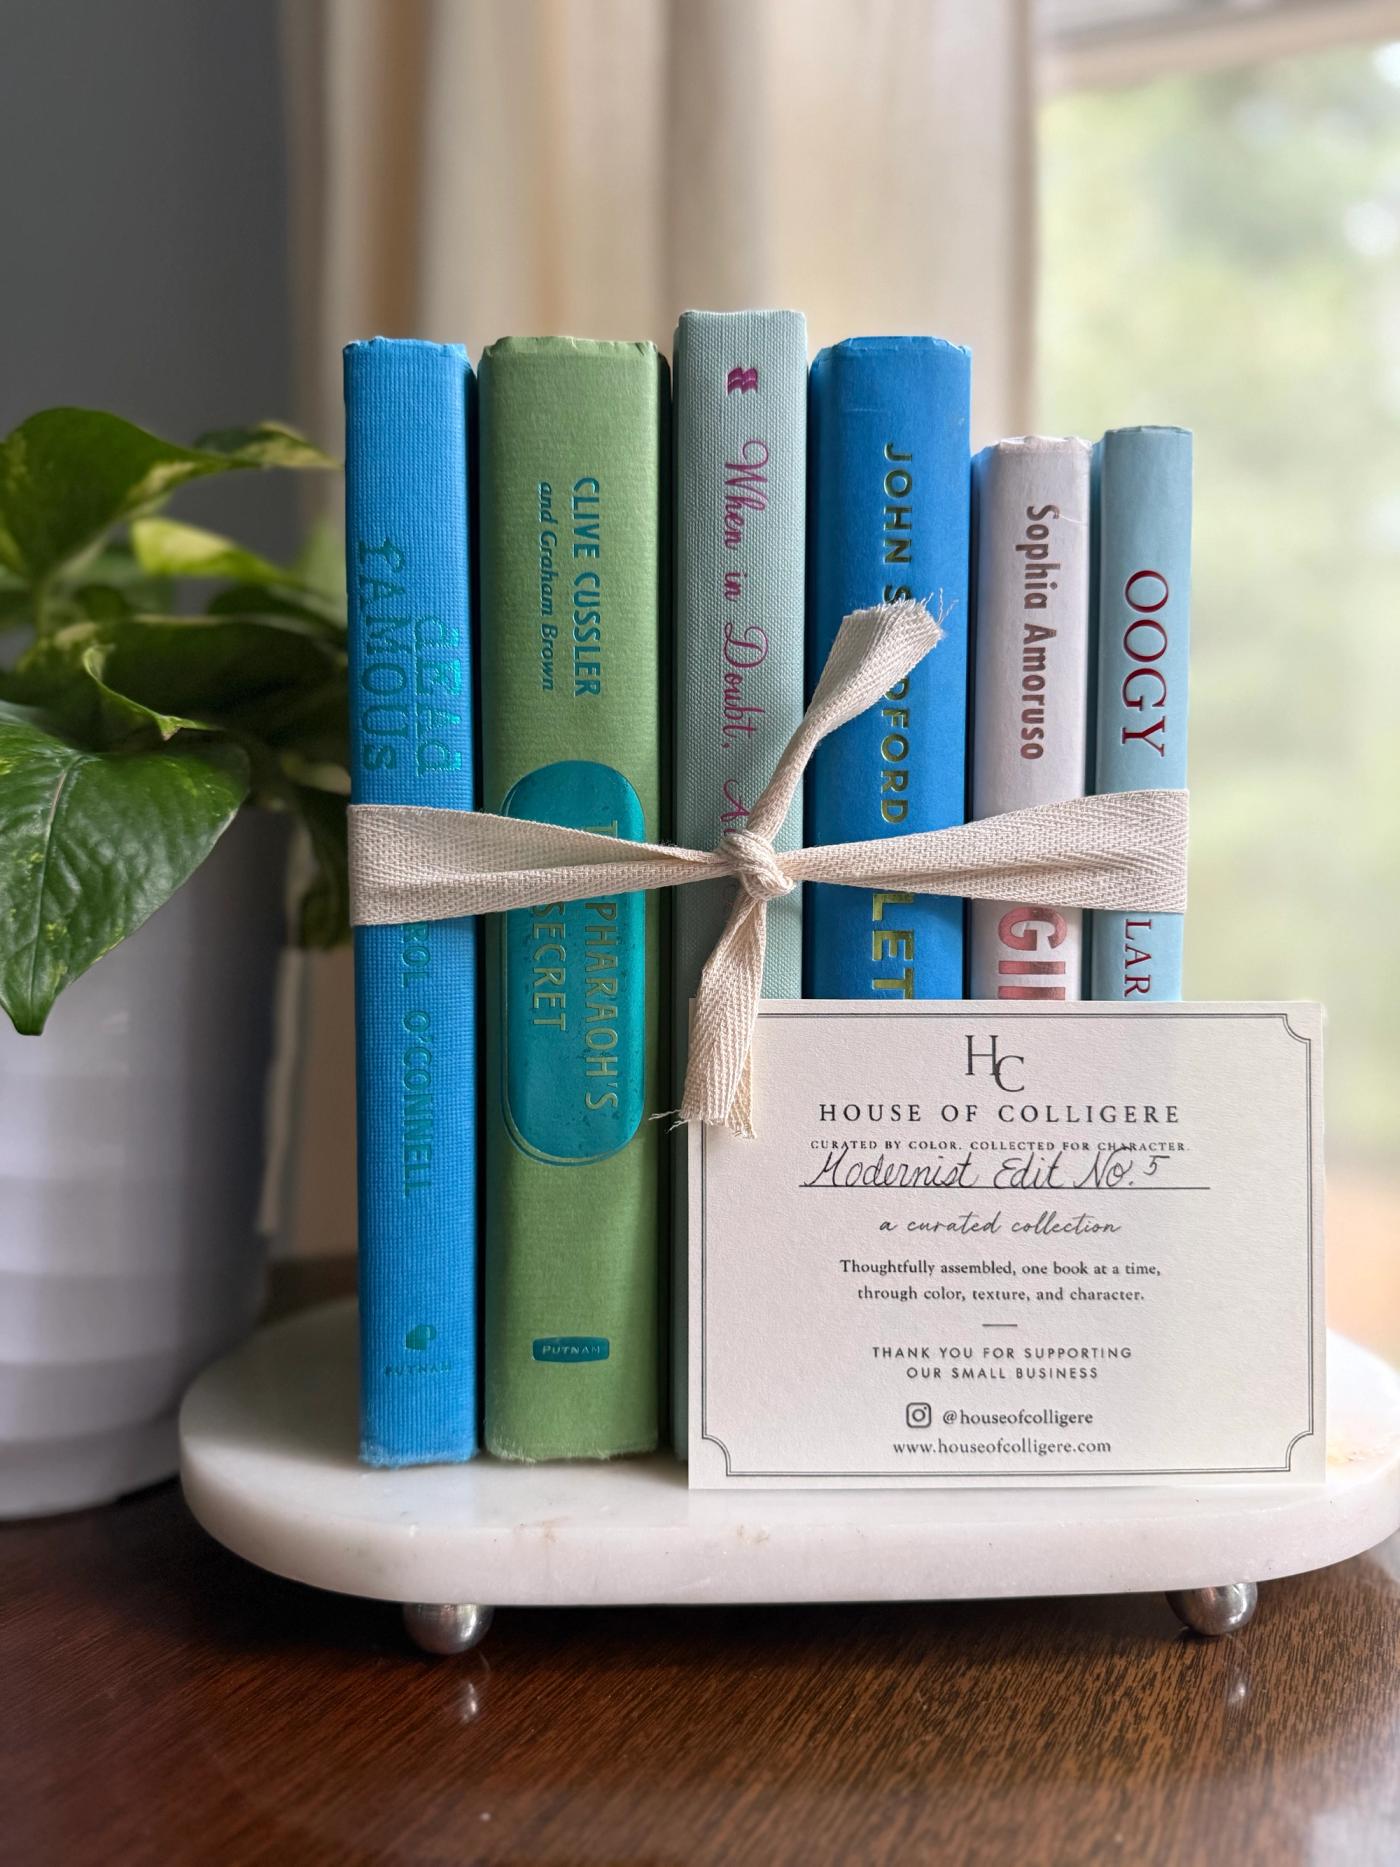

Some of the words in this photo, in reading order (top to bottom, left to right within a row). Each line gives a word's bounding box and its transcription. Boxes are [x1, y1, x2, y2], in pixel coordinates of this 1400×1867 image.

[538, 482, 559, 524] and
[572, 476, 601, 559] CLIVE
[724, 439, 768, 550] When
[883, 441, 913, 564] JOHN
[540, 530, 560, 617] Graham
[724, 571, 748, 602] in
[1016, 504, 1060, 610] Sophia
[540, 623, 559, 692] Brown
[572, 571, 602, 698] CUSSLER
[1122, 569, 1169, 757] OOGY
[721, 622, 769, 749] Doubt,
[880, 584, 912, 824] SDFORD
[1020, 622, 1057, 760] Amoruso
[400, 920, 431, 988] ROL
[532, 902, 567, 1032] SECRET
[872, 892, 914, 1000] LET
[1124, 918, 1153, 998] LAR
[584, 902, 618, 1111] PHARAOH'S
[402, 1010, 434, 1199] O'CONNELL
[819, 1104, 922, 1122] HOUSE
[941, 1104, 979, 1122] OF
[999, 1104, 1181, 1124] COLLIGERE
[804, 1146, 981, 1188] Modernist
[993, 1151, 1065, 1189] Edit
[1143, 1155, 1171, 1176] 5
[810, 1140, 878, 1150] CURATED
[885, 1140, 902, 1150] BY
[970, 1141, 1055, 1151] COLLECTED
[1062, 1142, 1090, 1151] FOR
[879, 1219, 897, 1233] a
[907, 1210, 1002, 1234] curated
[1011, 1209, 1122, 1235] collection
[839, 1259, 936, 1276] Thoughtfully
[940, 1260, 1017, 1276] assembled,
[1021, 1265, 1048, 1275] one
[1053, 1261, 1089, 1275] book
[1093, 1263, 1108, 1275] at
[1112, 1266, 1120, 1275] a
[1125, 1261, 1161, 1277] time,
[858, 1286, 918, 1302] through
[923, 1287, 966, 1302] color,
[972, 1288, 1032, 1302] texture,
[1036, 1287, 1064, 1301] and
[1069, 1287, 1145, 1301] character.
[541, 1344, 600, 1355] PUTNAM
[872, 1347, 931, 1359] THANK
[939, 1347, 974, 1359] YOU
[983, 1347, 1016, 1359] FOR
[1023, 1347, 1133, 1359] SUPPORTING
[906, 1367, 943, 1379] OUR
[951, 1367, 1007, 1379] SMALL
[1015, 1367, 1099, 1379] BUSINESS
[893, 1438, 1111, 1456] www.houseofcolligere.com
[942, 1408, 1094, 1428] @houseofcolligere
